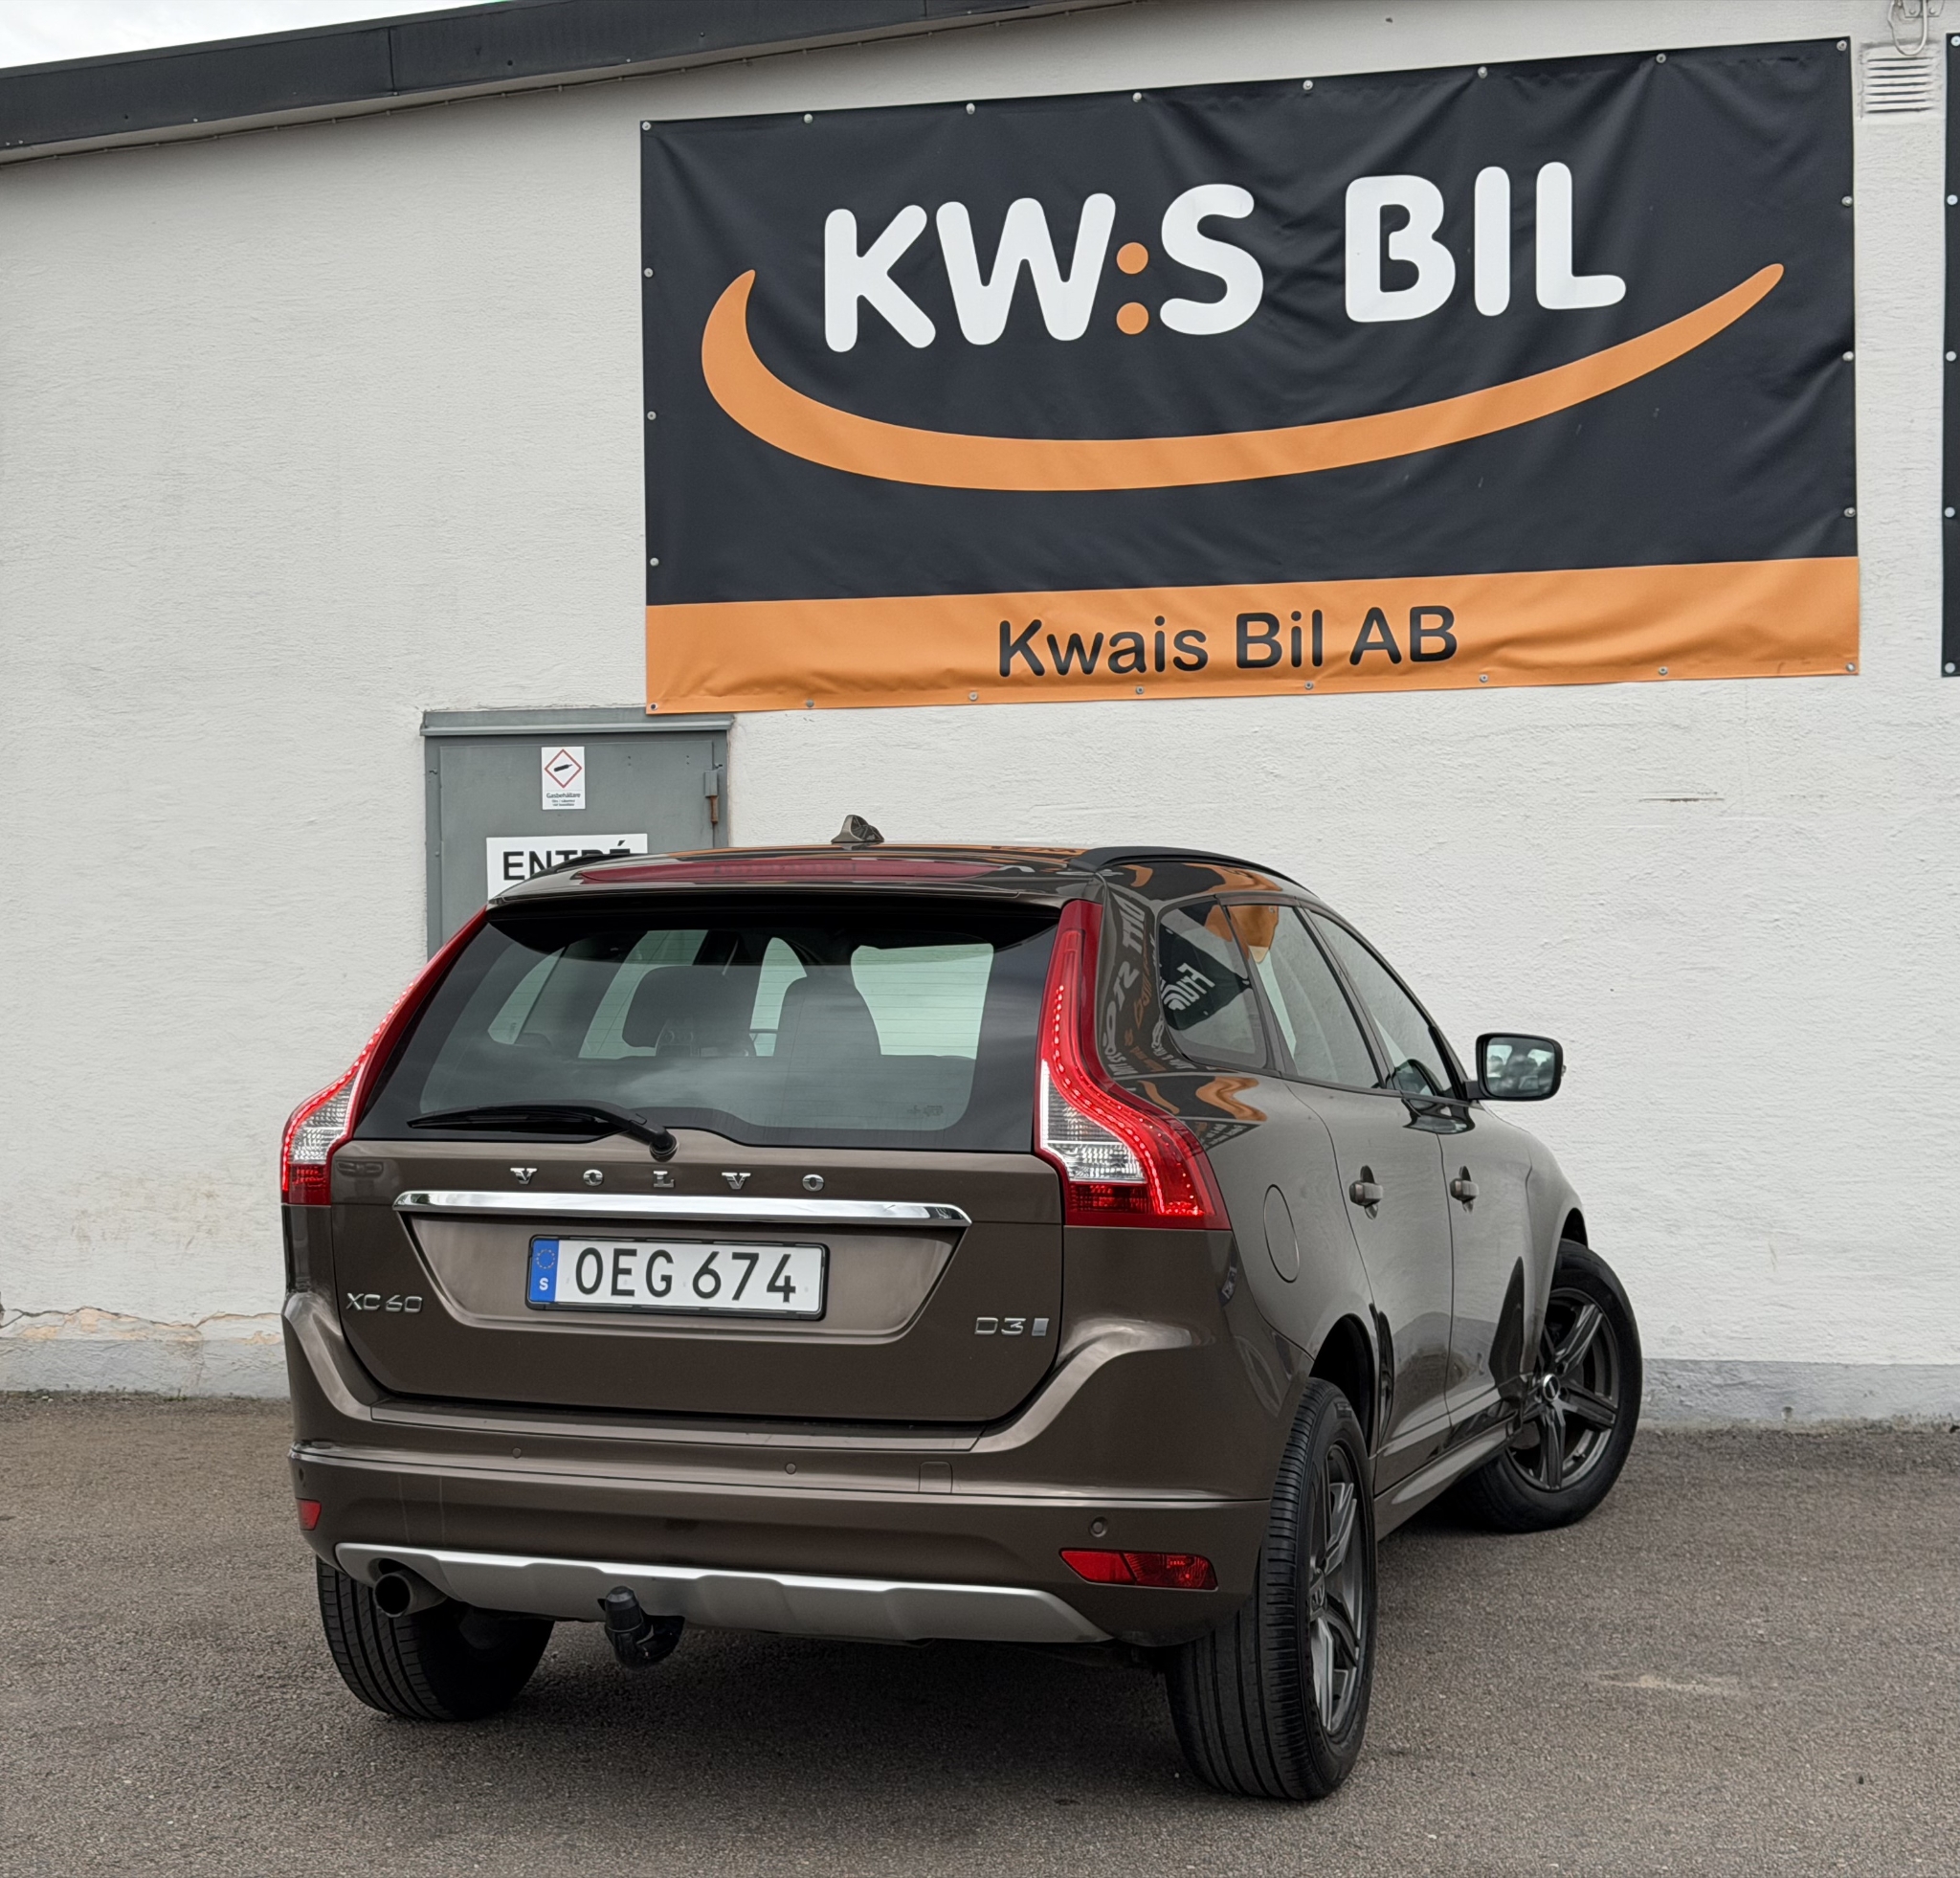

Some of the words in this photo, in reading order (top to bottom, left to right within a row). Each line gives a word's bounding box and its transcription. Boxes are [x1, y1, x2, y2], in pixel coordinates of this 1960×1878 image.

[824, 183, 1264, 352] KW:S
[1345, 162, 1627, 323] BIL
[999, 615, 1209, 677] Kwais
[1236, 609, 1323, 668] Bil
[1349, 605, 1458, 665] AB
[510, 1168, 824, 1191] VOLVO
[539, 1277, 548, 1290] S
[575, 1247, 674, 1298] OEG
[692, 1251, 796, 1303] 674
[974, 1317, 1026, 1335] D3
